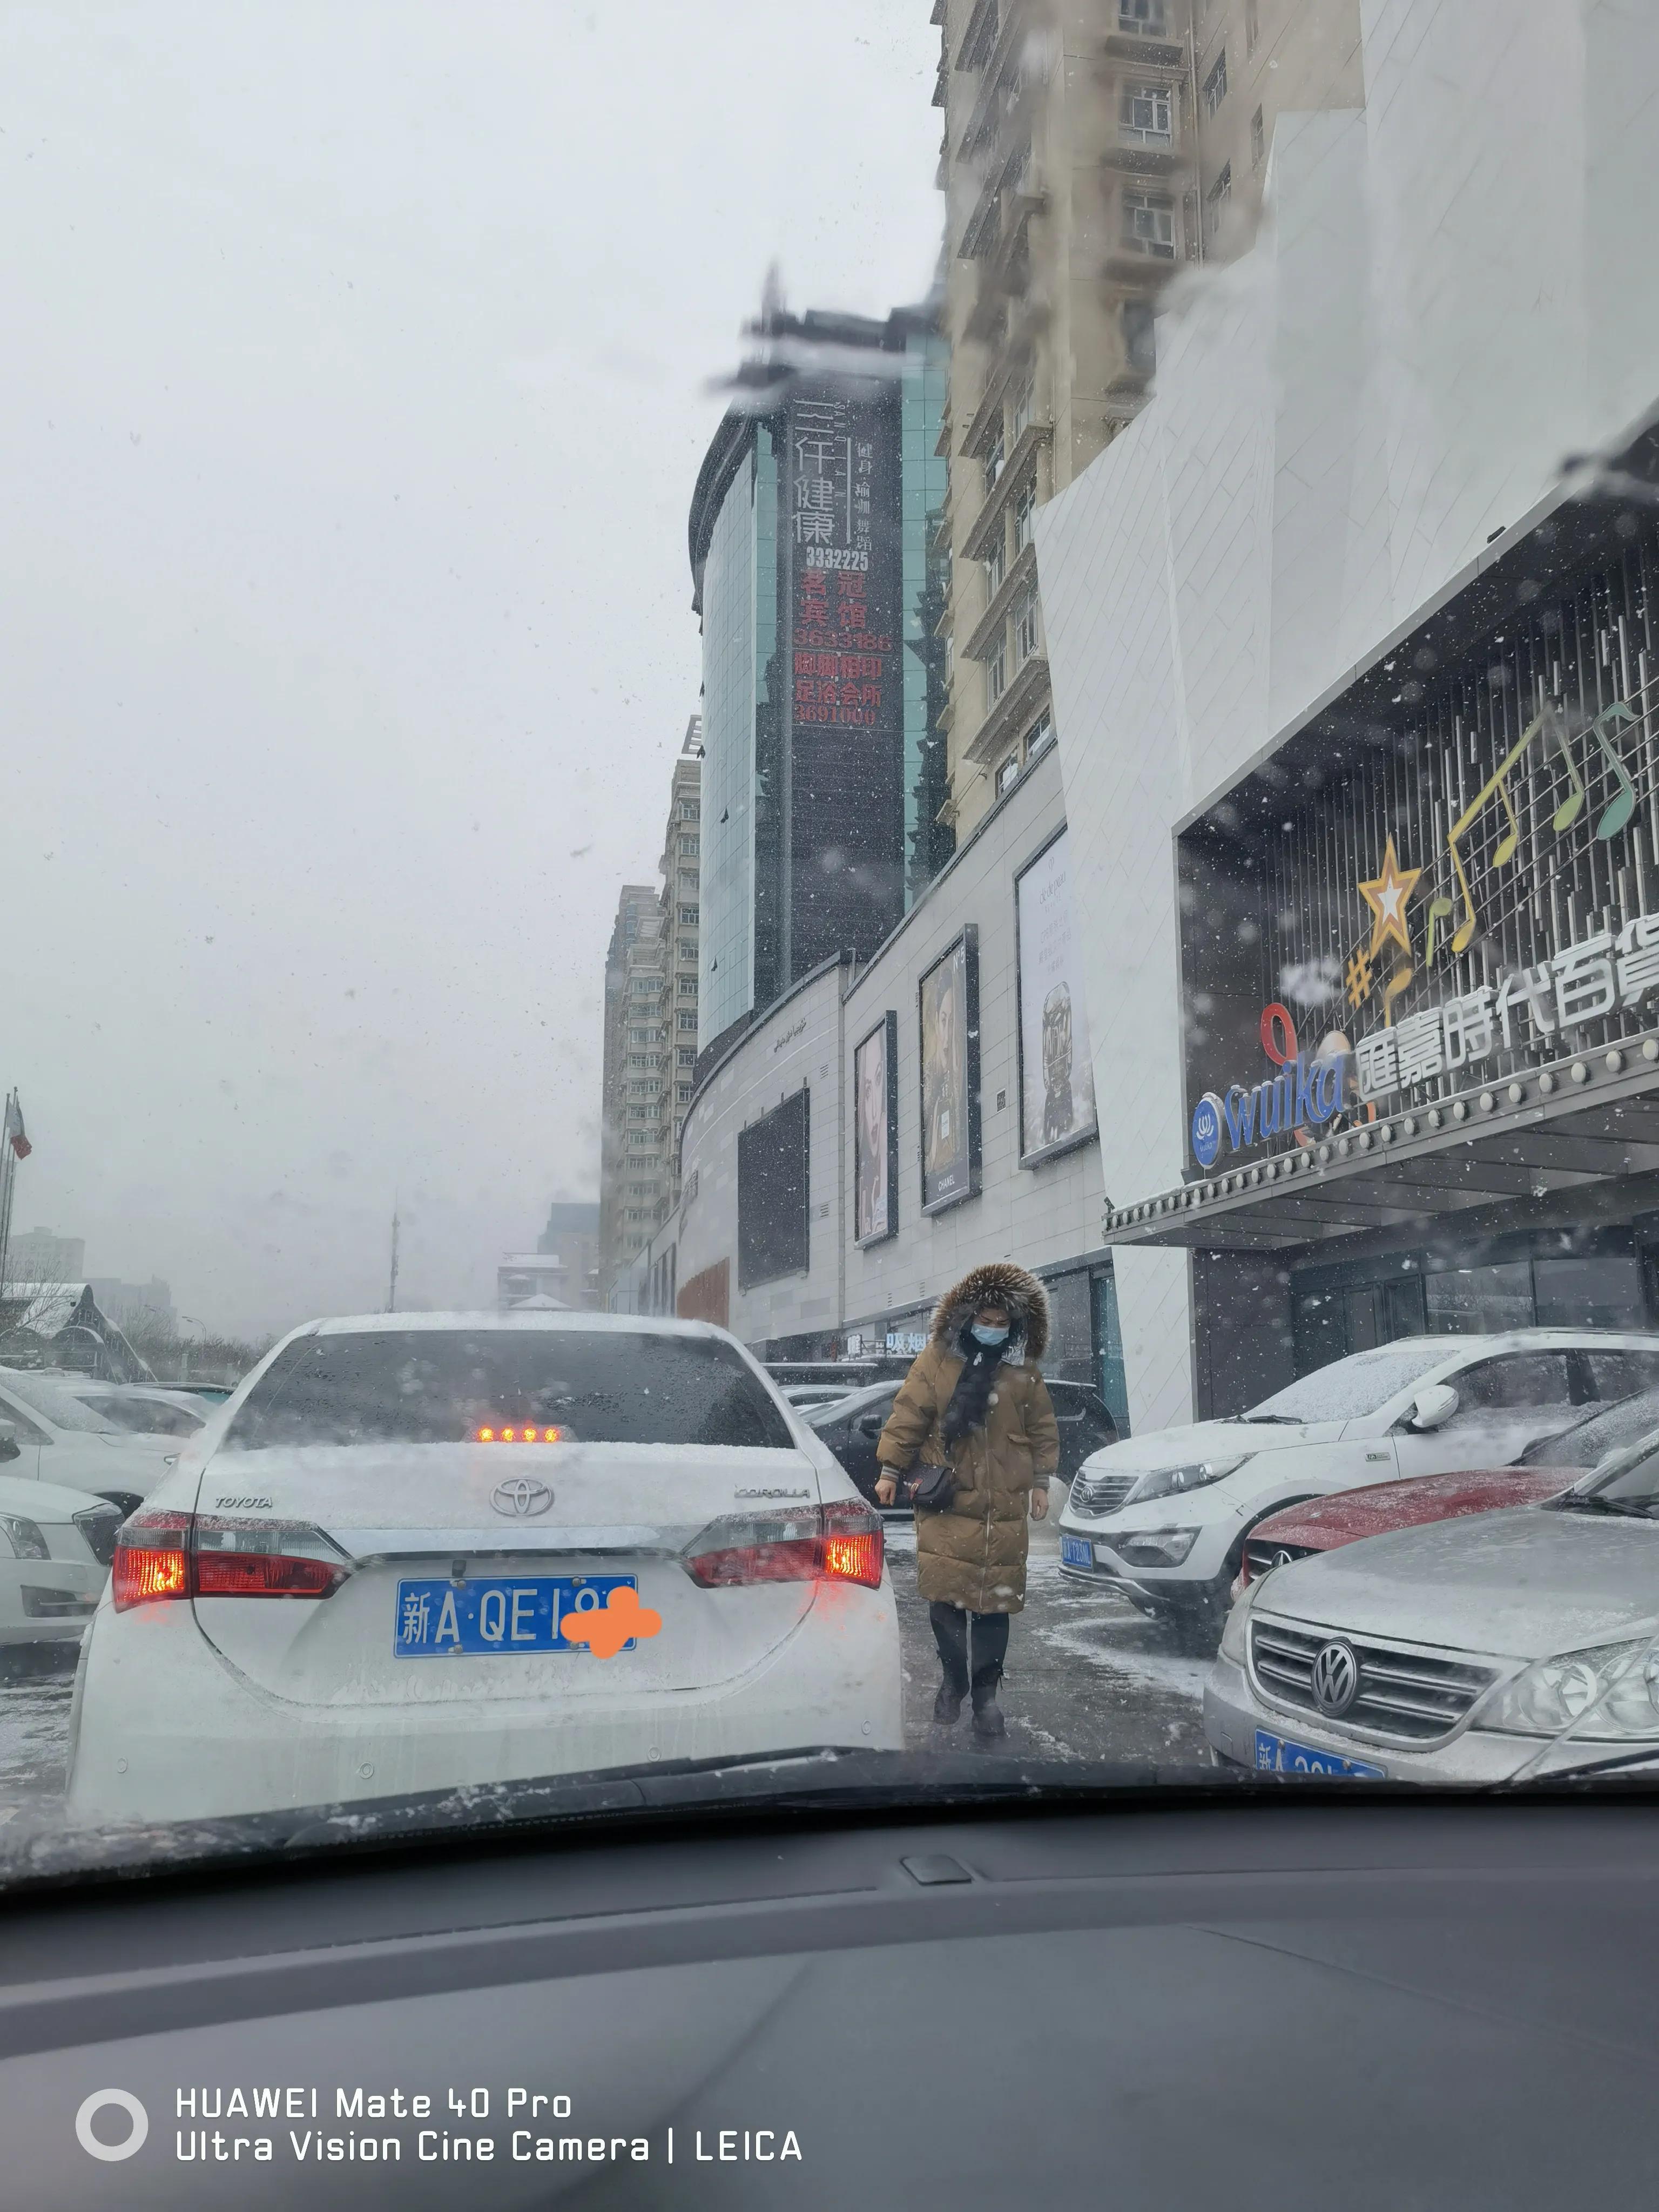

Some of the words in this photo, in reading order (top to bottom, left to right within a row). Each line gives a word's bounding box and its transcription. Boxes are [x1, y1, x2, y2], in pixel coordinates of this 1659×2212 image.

[806, 547, 868, 571] 3332225
[799, 599, 867, 629] 宾馆
[795, 679, 882, 707] 足浴会所
[938, 1174, 955, 1191] CHANEL
[215, 1497, 273, 1508] TOYOTA
[734, 1488, 810, 1499] COROLLA
